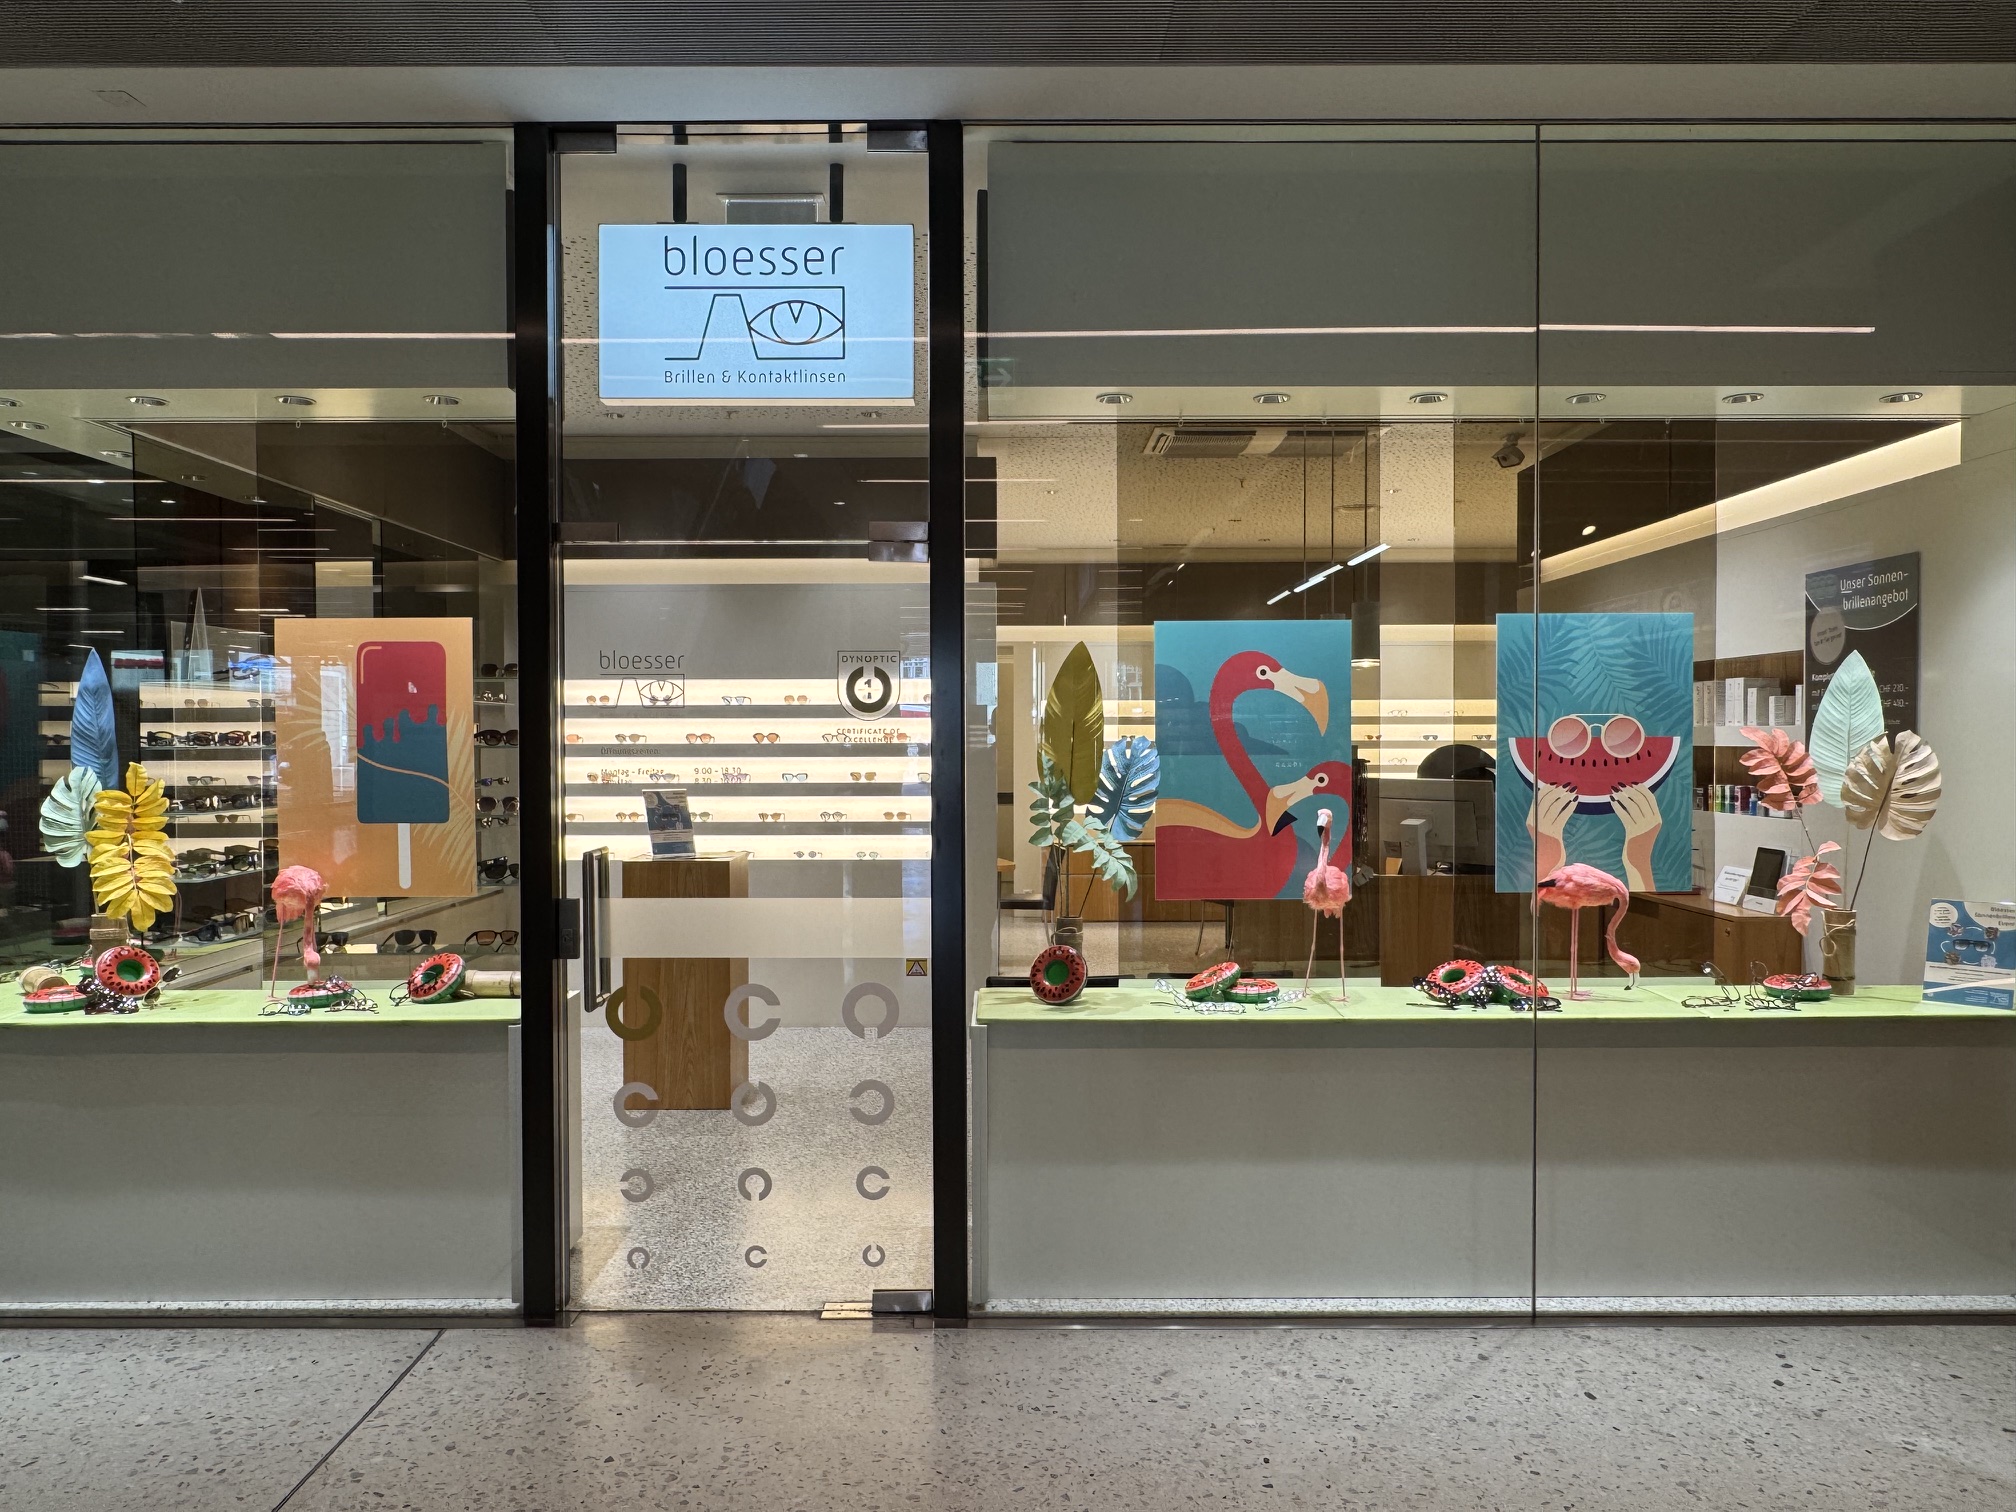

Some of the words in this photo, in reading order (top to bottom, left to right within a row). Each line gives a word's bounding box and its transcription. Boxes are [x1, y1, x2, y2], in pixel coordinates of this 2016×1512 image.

[664, 235, 845, 276] bloesser
[664, 370, 715, 384] Brillen
[721, 371, 732, 384] &
[737, 369, 846, 384] Kontaktlinsen
[1840, 578, 1866, 591] Unser
[1867, 571, 1909, 587] Sonnen-
[1842, 588, 1909, 611] brillenangebot
[600, 650, 685, 670] bloesser
[841, 655, 897, 663] DYNOPTIC
